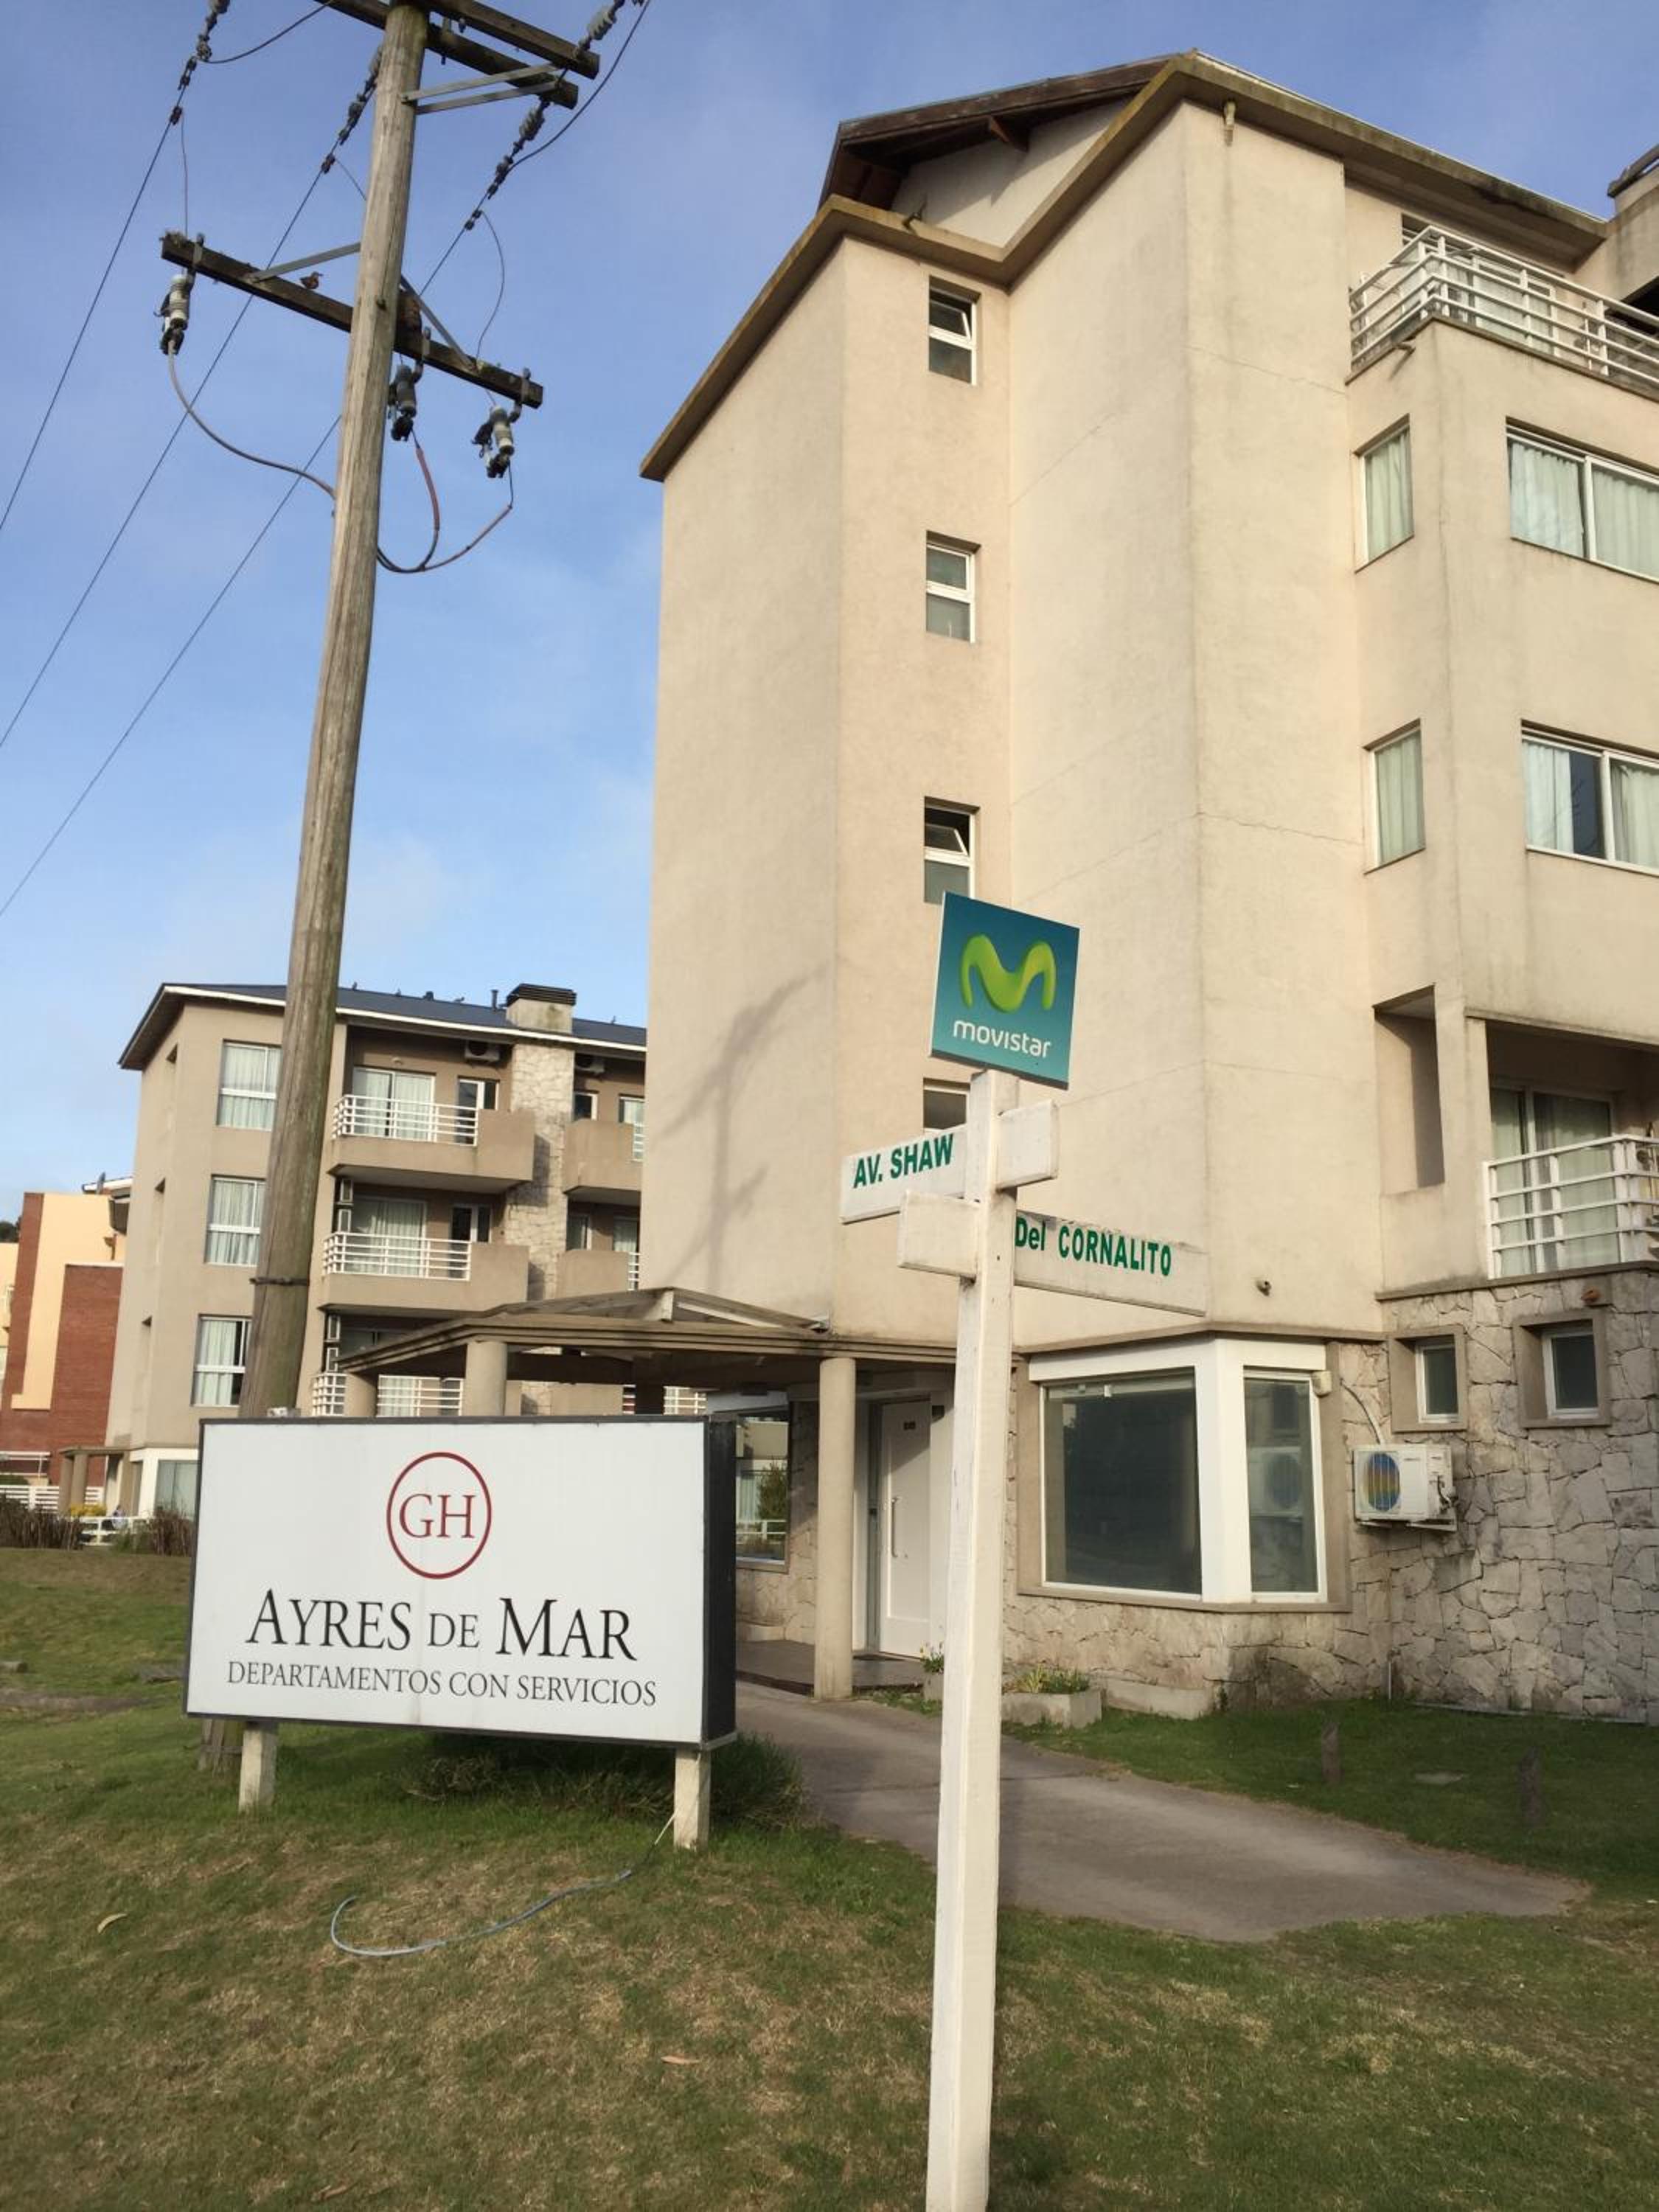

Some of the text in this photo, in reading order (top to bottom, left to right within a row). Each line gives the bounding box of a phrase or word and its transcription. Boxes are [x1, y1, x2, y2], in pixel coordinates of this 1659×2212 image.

[953, 1020, 1051, 1059] movistar
[853, 1133, 954, 1189] AV. SHAW
[1015, 1217, 1171, 1276] Del CORNALITO
[398, 1493, 476, 1539] GH
[245, 1588, 637, 1661] AYRES DE MAR
[228, 1660, 657, 1707] DEPARTAMENTOS CON SERVICIOS
